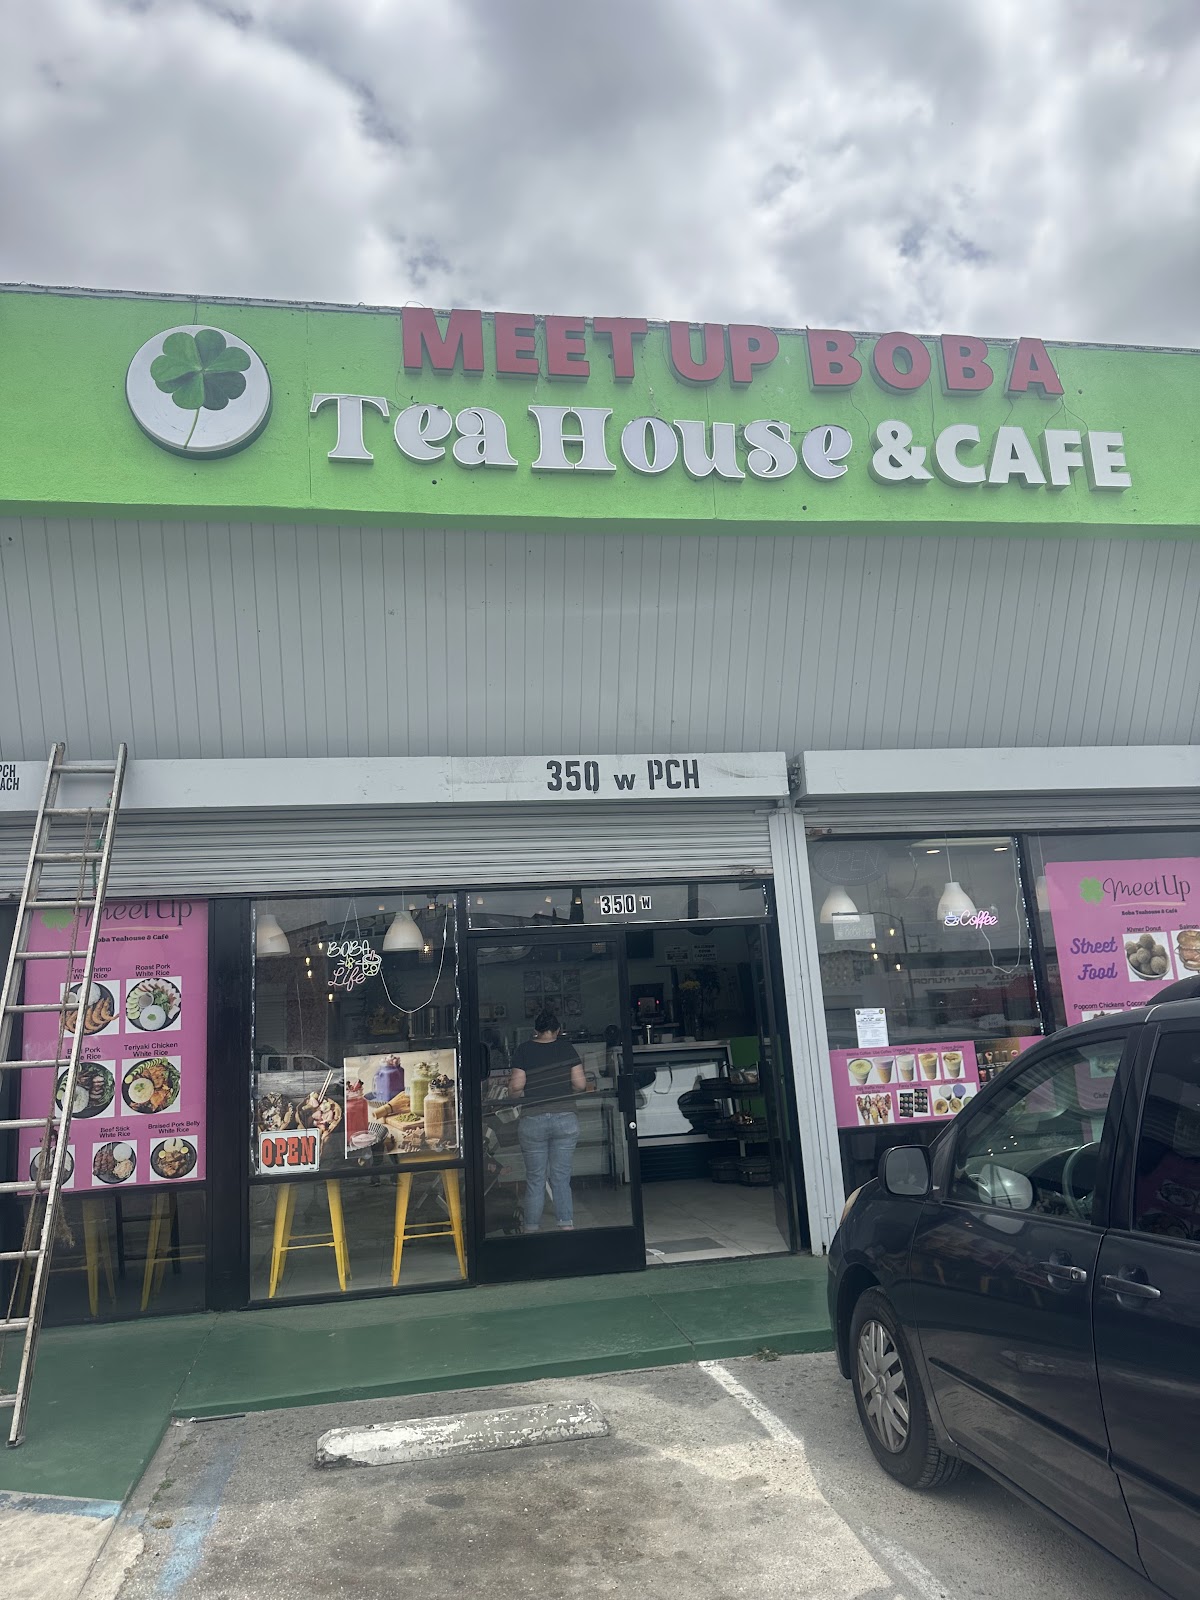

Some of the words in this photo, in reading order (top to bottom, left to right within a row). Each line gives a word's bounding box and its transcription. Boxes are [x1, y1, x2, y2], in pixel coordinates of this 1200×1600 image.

[402, 307, 648, 382] MEET
[669, 321, 779, 387] UP
[806, 330, 1064, 396] BOBA
[309, 393, 518, 468] Tea
[528, 405, 852, 481] House
[547, 760, 600, 791] 350
[647, 759, 699, 790] PCH
[820, 848, 880, 872] OPEN
[601, 895, 635, 914] 350
[960, 910, 998, 929] Coffee
[111, 934, 146, 942] Teahouse
[1070, 936, 1118, 954] Street
[327, 939, 371, 957] BOBA
[93, 966, 112, 974] hrimp
[328, 967, 366, 991] Life
[1077, 962, 1118, 980] Food
[85, 1046, 101, 1054] Pork
[124, 1043, 150, 1051] Teriyaki
[151, 1041, 178, 1049] Chicken
[185, 1119, 201, 1127] Belly
[261, 1135, 318, 1167] OPEN
